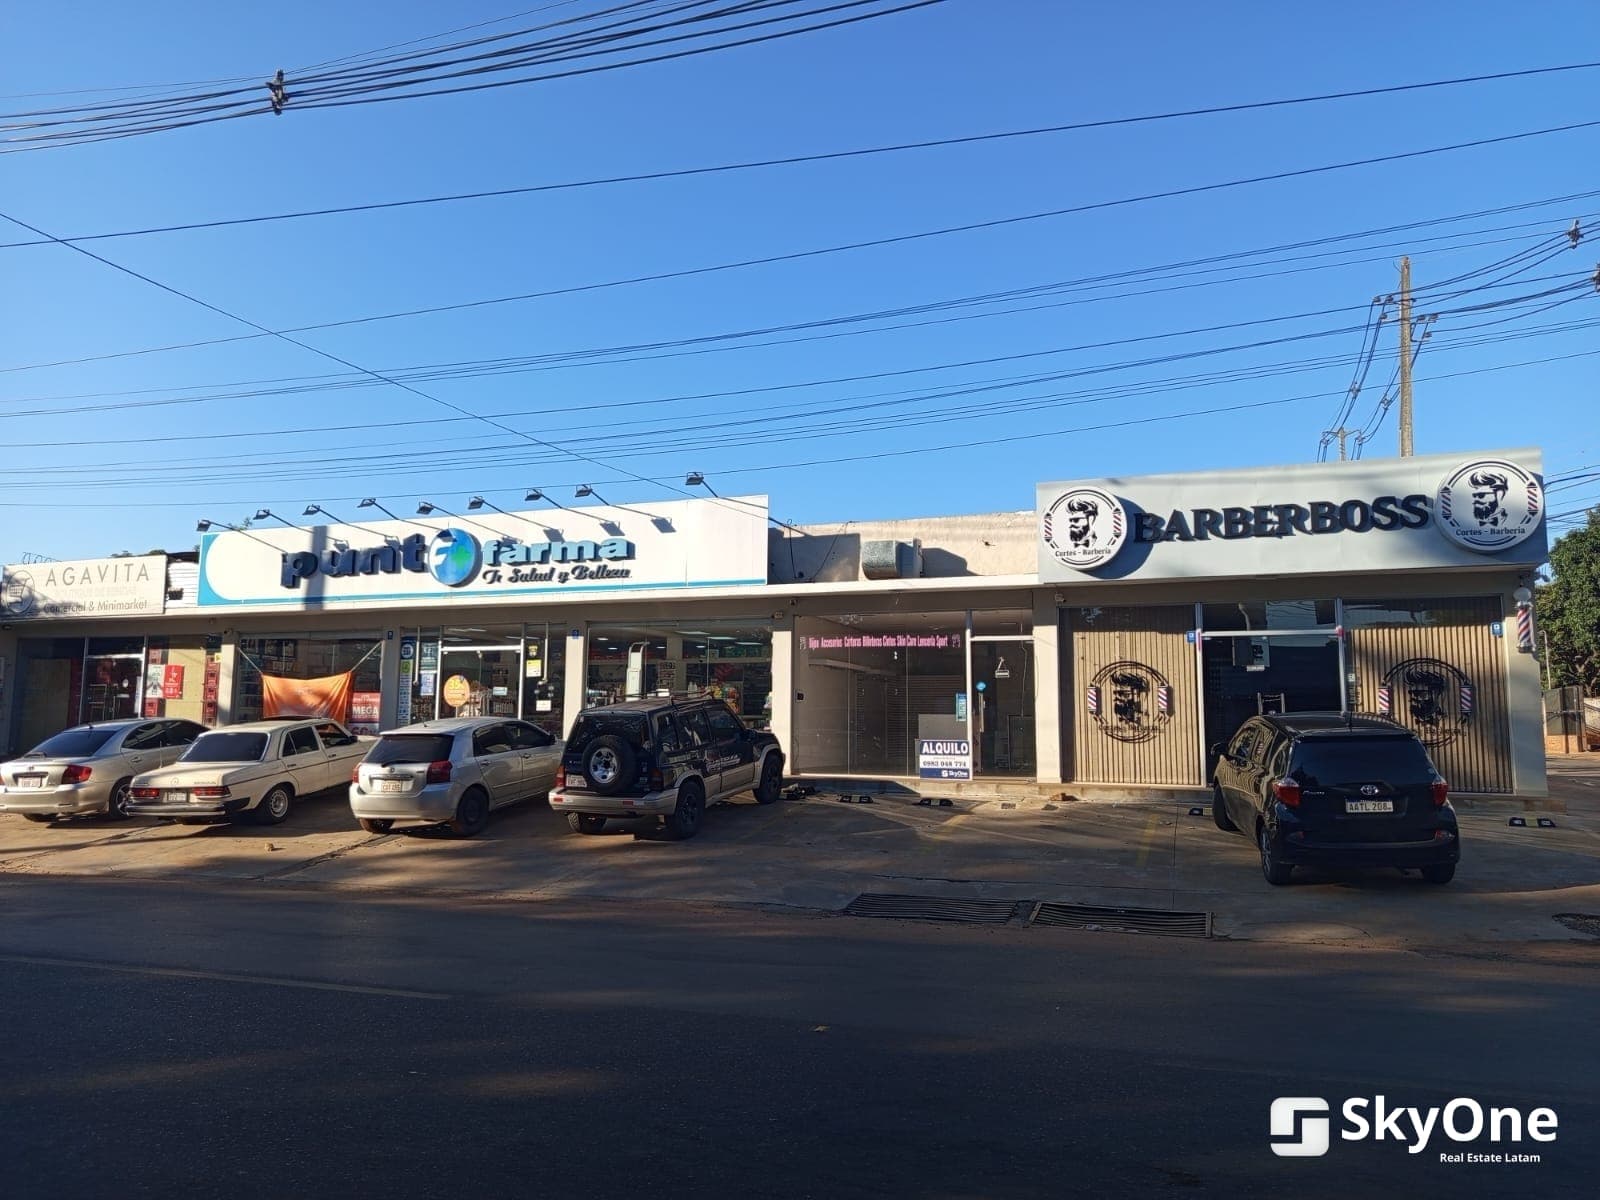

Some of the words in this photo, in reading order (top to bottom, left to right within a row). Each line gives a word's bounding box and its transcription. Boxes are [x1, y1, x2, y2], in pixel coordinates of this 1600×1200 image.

[1134, 494, 1430, 544] BARBERBOSS
[483, 538, 636, 567] farma
[46, 563, 149, 587] AGAVITA
[508, 566, 556, 583] Salud
[571, 564, 631, 580] Belleza
[88, 601, 95, 612] &
[98, 598, 148, 611] Minimarket
[352, 705, 379, 715] MEGA
[922, 742, 969, 754] ALQUILO
